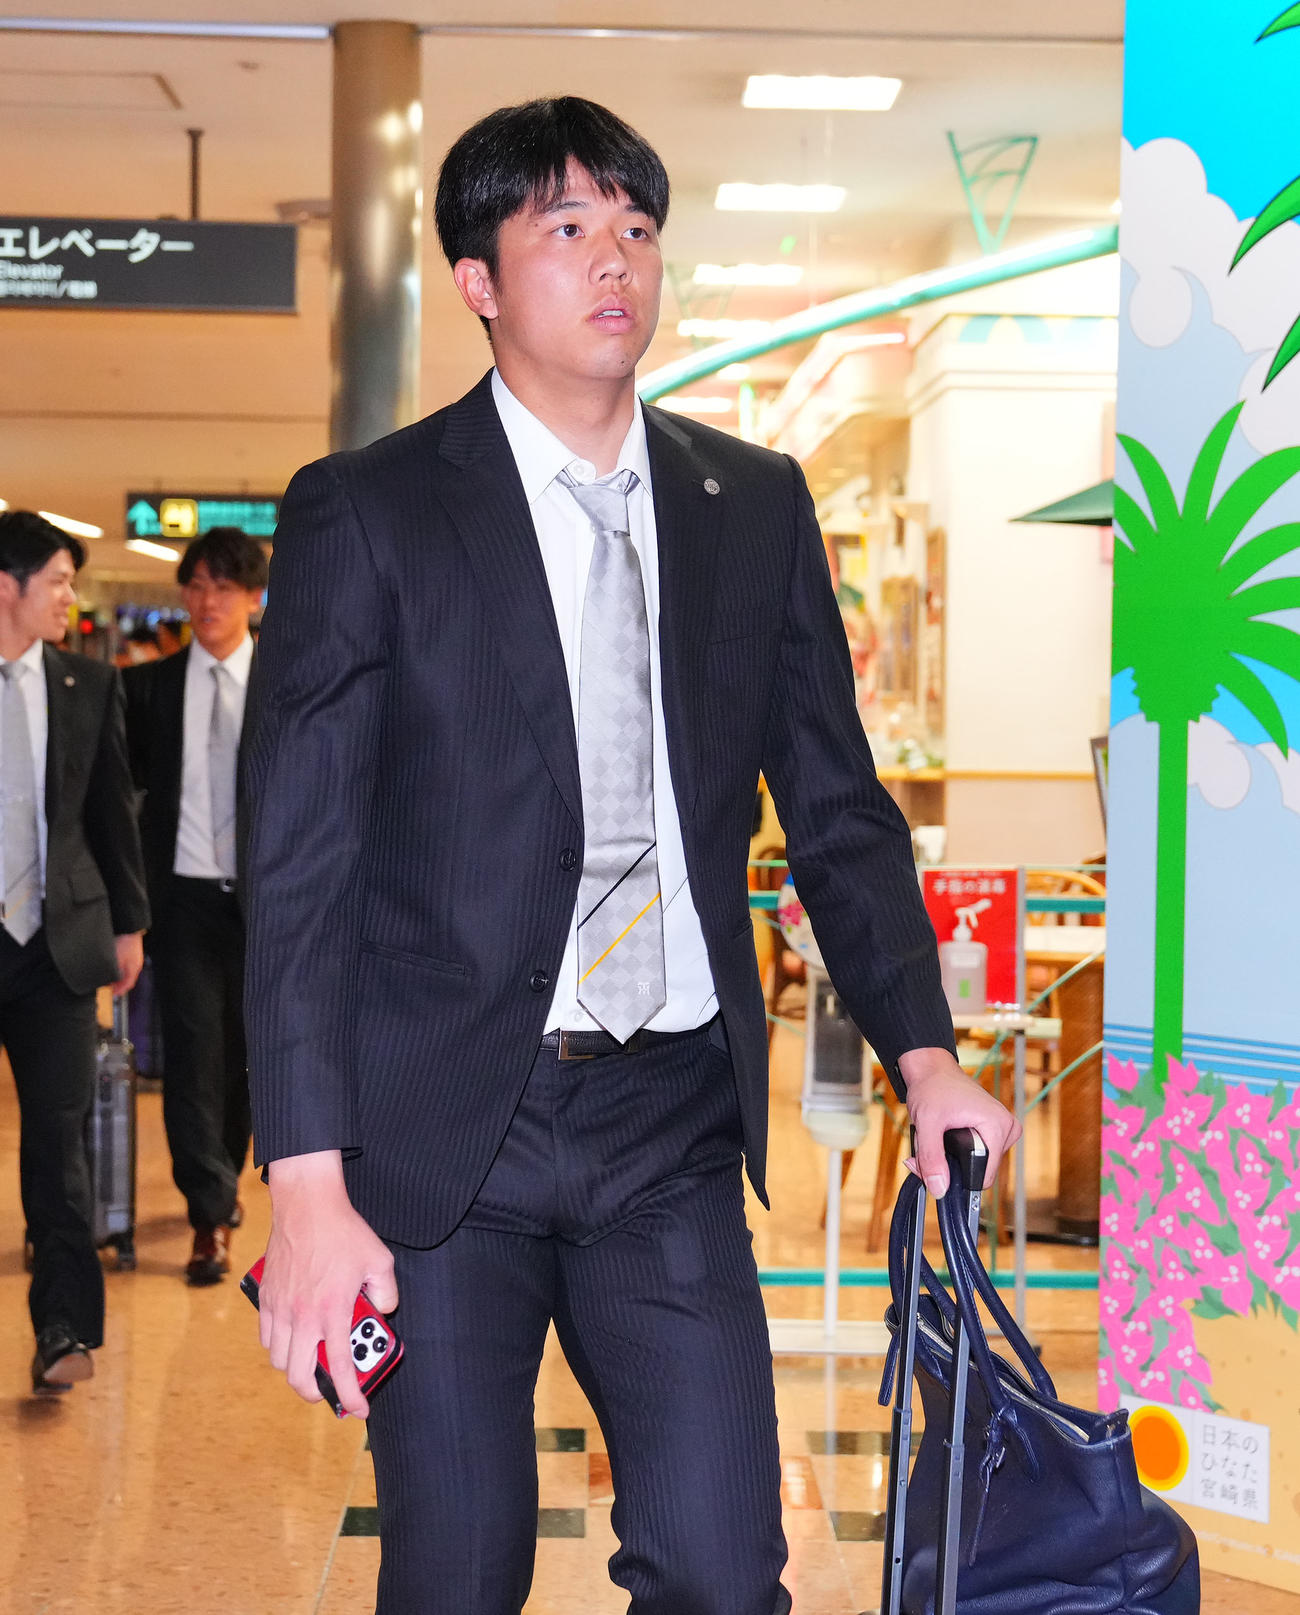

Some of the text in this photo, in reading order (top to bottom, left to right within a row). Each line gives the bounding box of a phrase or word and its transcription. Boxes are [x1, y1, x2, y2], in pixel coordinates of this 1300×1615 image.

[0, 226, 194, 263] エレベーター
[1203, 1424, 1259, 1454] 日本の
[1201, 1452, 1257, 1484] ひなた
[1201, 1478, 1258, 1510] 宮崎県
